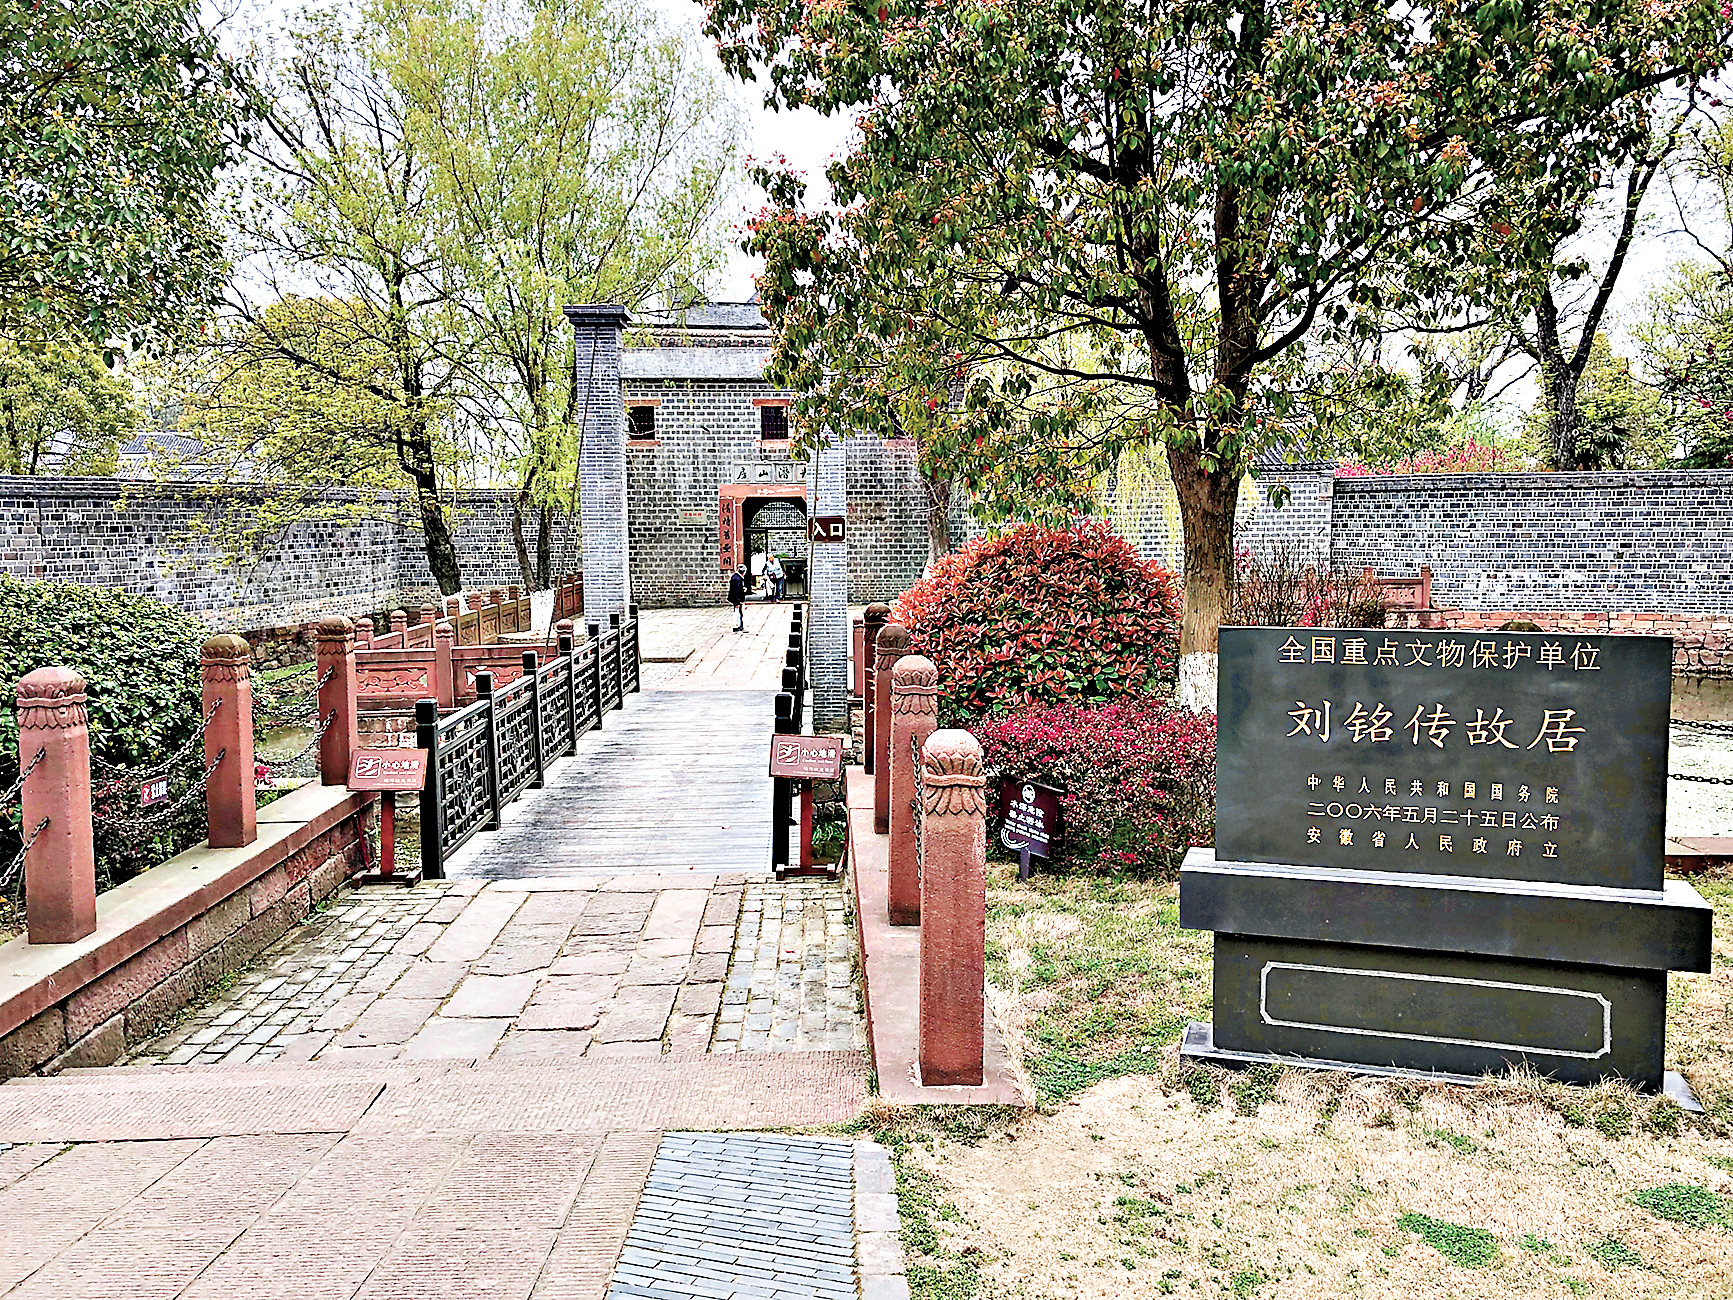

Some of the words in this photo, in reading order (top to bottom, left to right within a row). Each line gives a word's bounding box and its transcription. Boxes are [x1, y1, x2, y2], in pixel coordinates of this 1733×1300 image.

[813, 521, 843, 538] 入口
[1277, 635, 1602, 671] 全国重点文物保护单位
[1286, 699, 1587, 754] 刘铭传故居
[381, 760, 419, 770] 小心地滑
[801, 748, 836, 759] 小心地滑
[1307, 773, 1559, 804] 中华人民共和国国务院
[1307, 826, 1558, 859] 安徽省人民政府立
